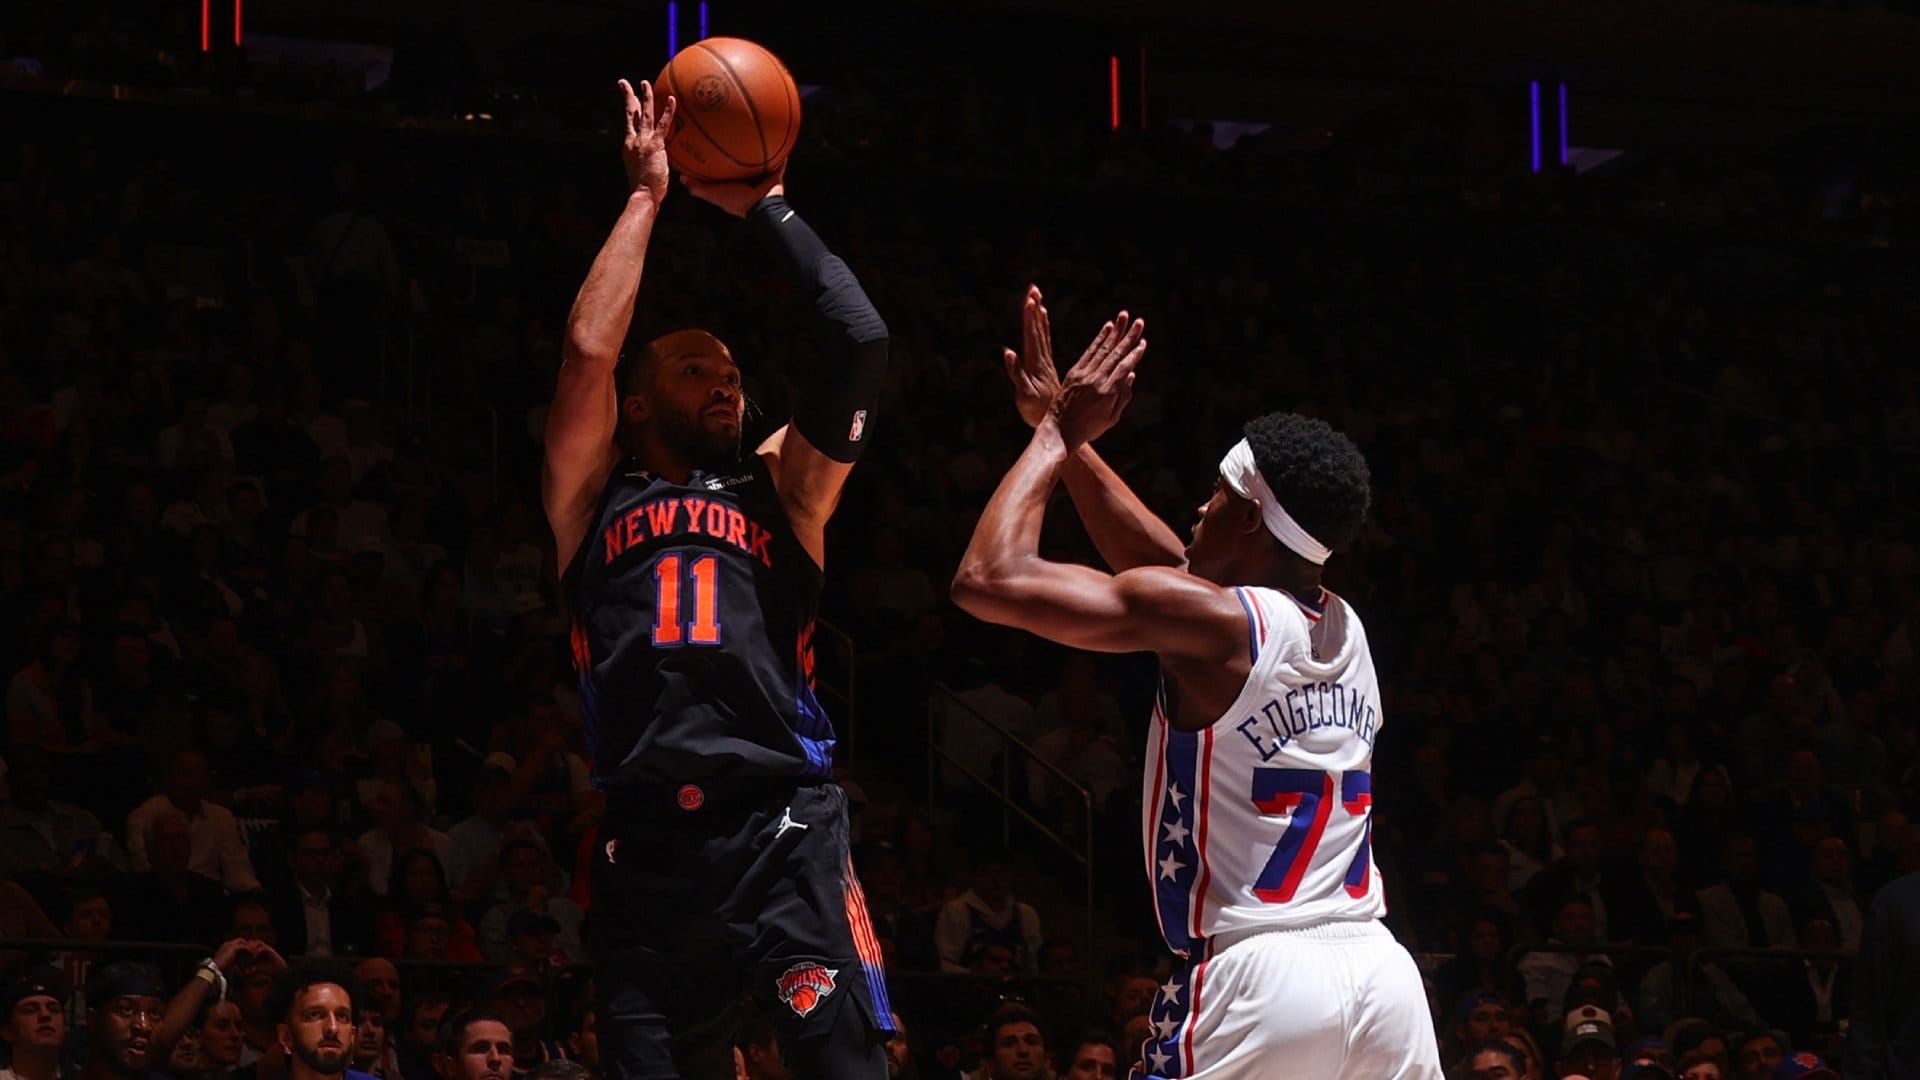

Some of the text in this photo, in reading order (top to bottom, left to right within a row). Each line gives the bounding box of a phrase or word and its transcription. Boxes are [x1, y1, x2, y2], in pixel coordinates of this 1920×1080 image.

[604, 497, 774, 569] NEW YORK
[652, 551, 722, 647] 11
[1252, 767, 1373, 904] 77
